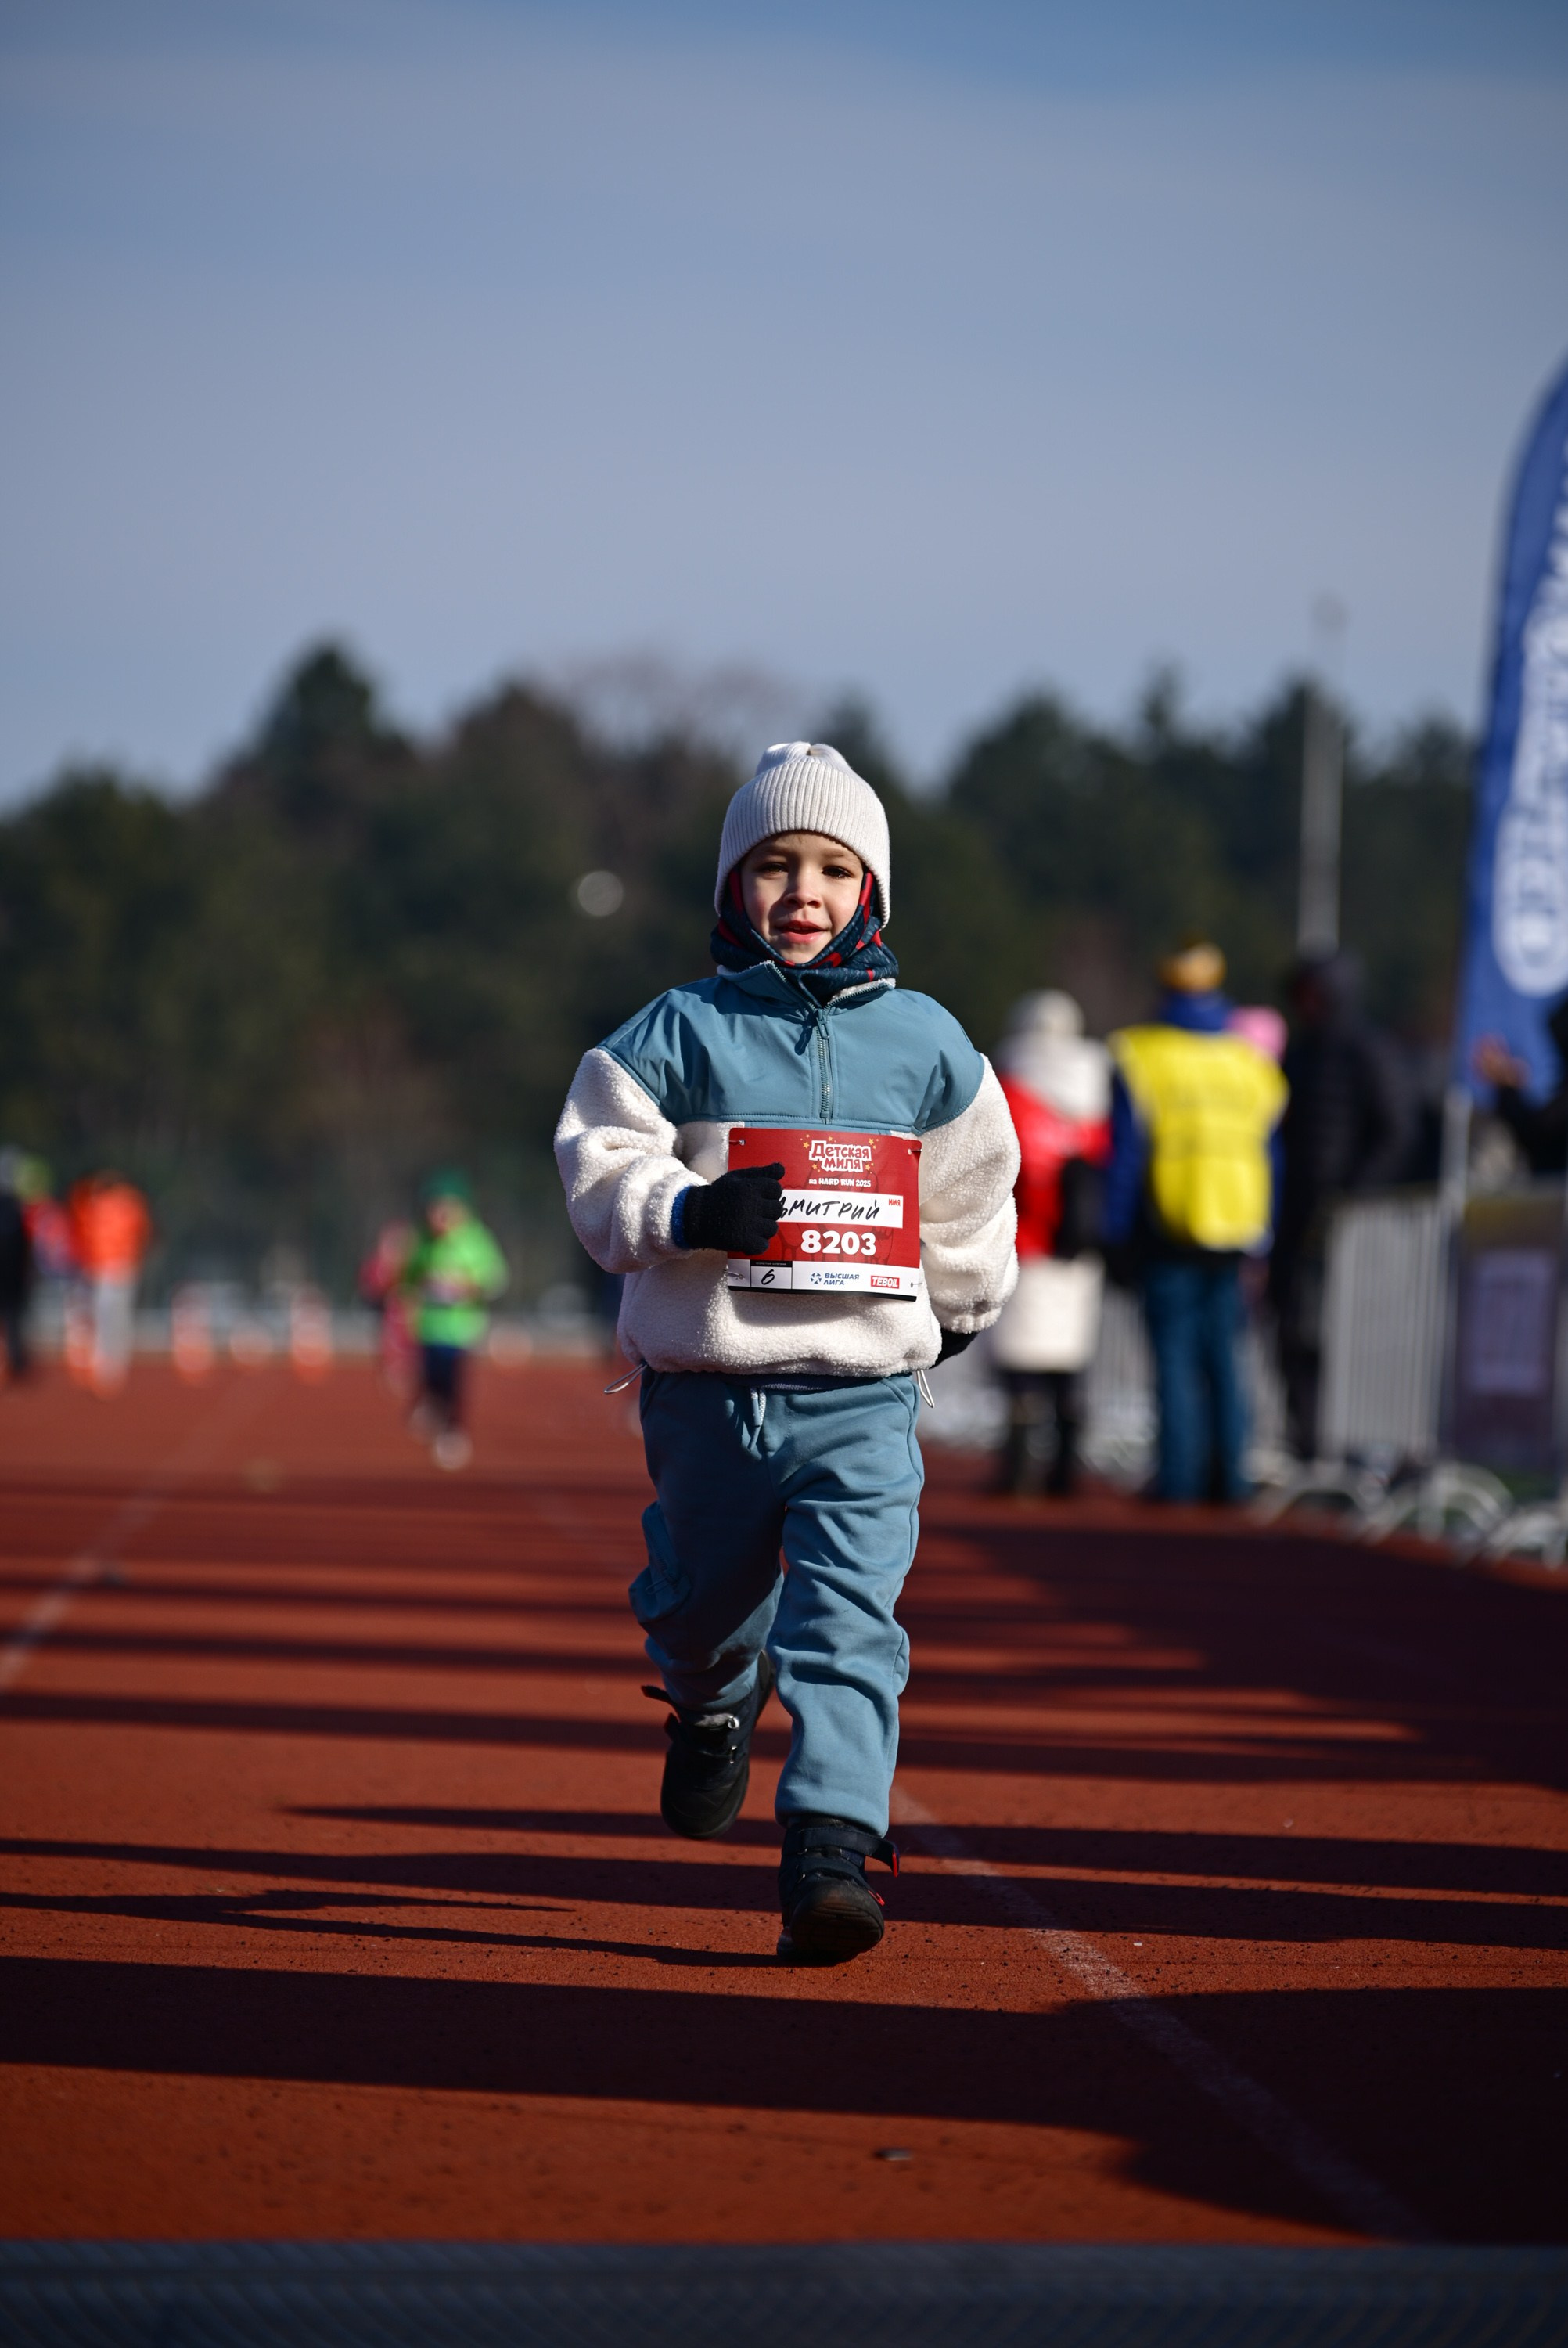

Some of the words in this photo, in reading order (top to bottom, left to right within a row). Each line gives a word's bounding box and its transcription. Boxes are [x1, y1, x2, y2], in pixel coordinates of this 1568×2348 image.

[811, 1142, 870, 1159] Детская
[840, 1179, 854, 1187] RUN
[855, 1179, 872, 1188] 2025
[800, 1230, 876, 1256] 8203
[761, 1269, 775, 1285] 6
[872, 1277, 899, 1288] TEBOIL
